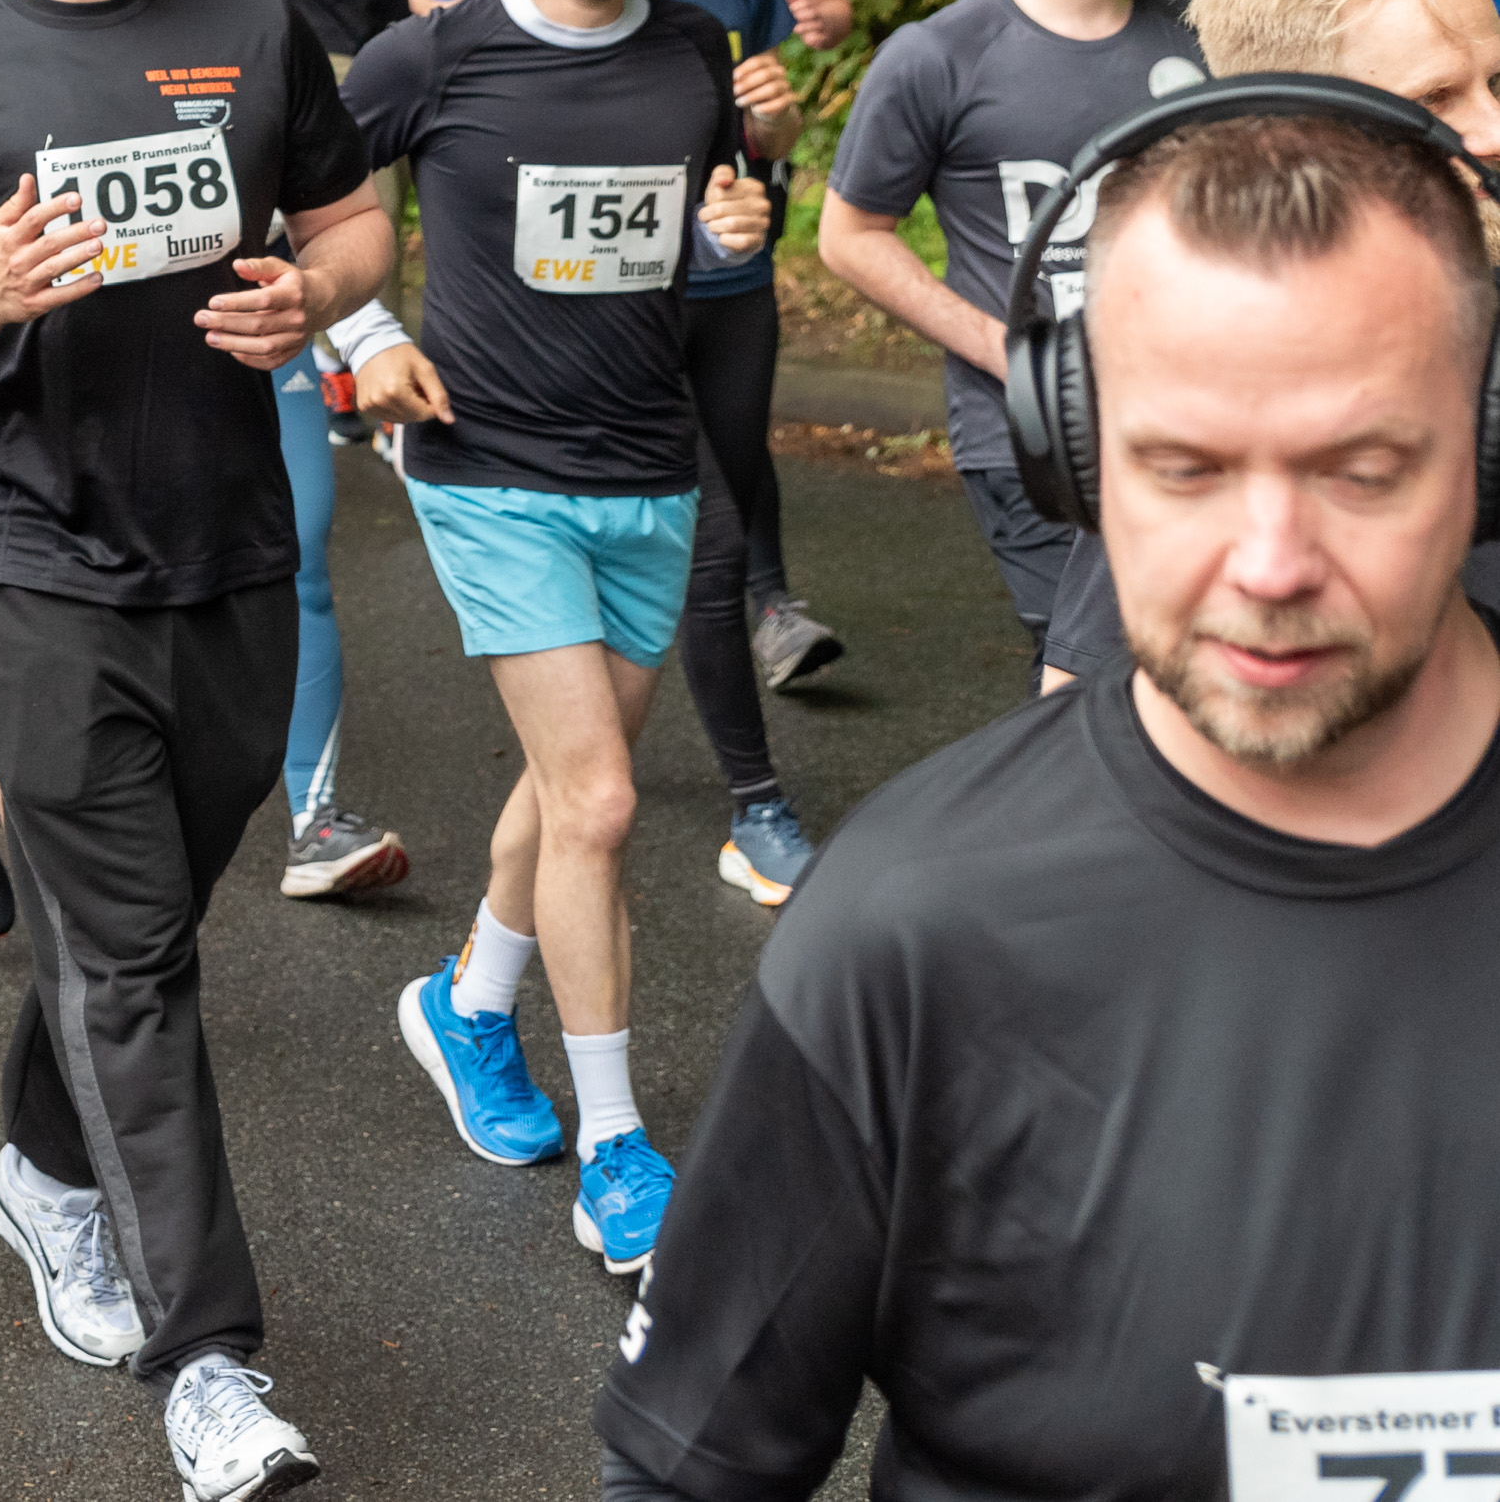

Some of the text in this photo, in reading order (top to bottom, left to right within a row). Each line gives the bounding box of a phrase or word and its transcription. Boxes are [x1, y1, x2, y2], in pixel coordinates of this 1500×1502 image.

[160, 84, 187, 96] MEHR
[51, 139, 212, 173] Everstener Brunnenlauf
[50, 157, 228, 227] 1058
[533, 177, 677, 188] Everstener Brunnenlauf
[549, 192, 660, 240] 154
[115, 223, 173, 239] Maurice
[166, 233, 224, 258] bruns
[532, 258, 597, 282] EWE
[619, 256, 666, 277] bruns
[1268, 1409, 1477, 1434] Everstener
